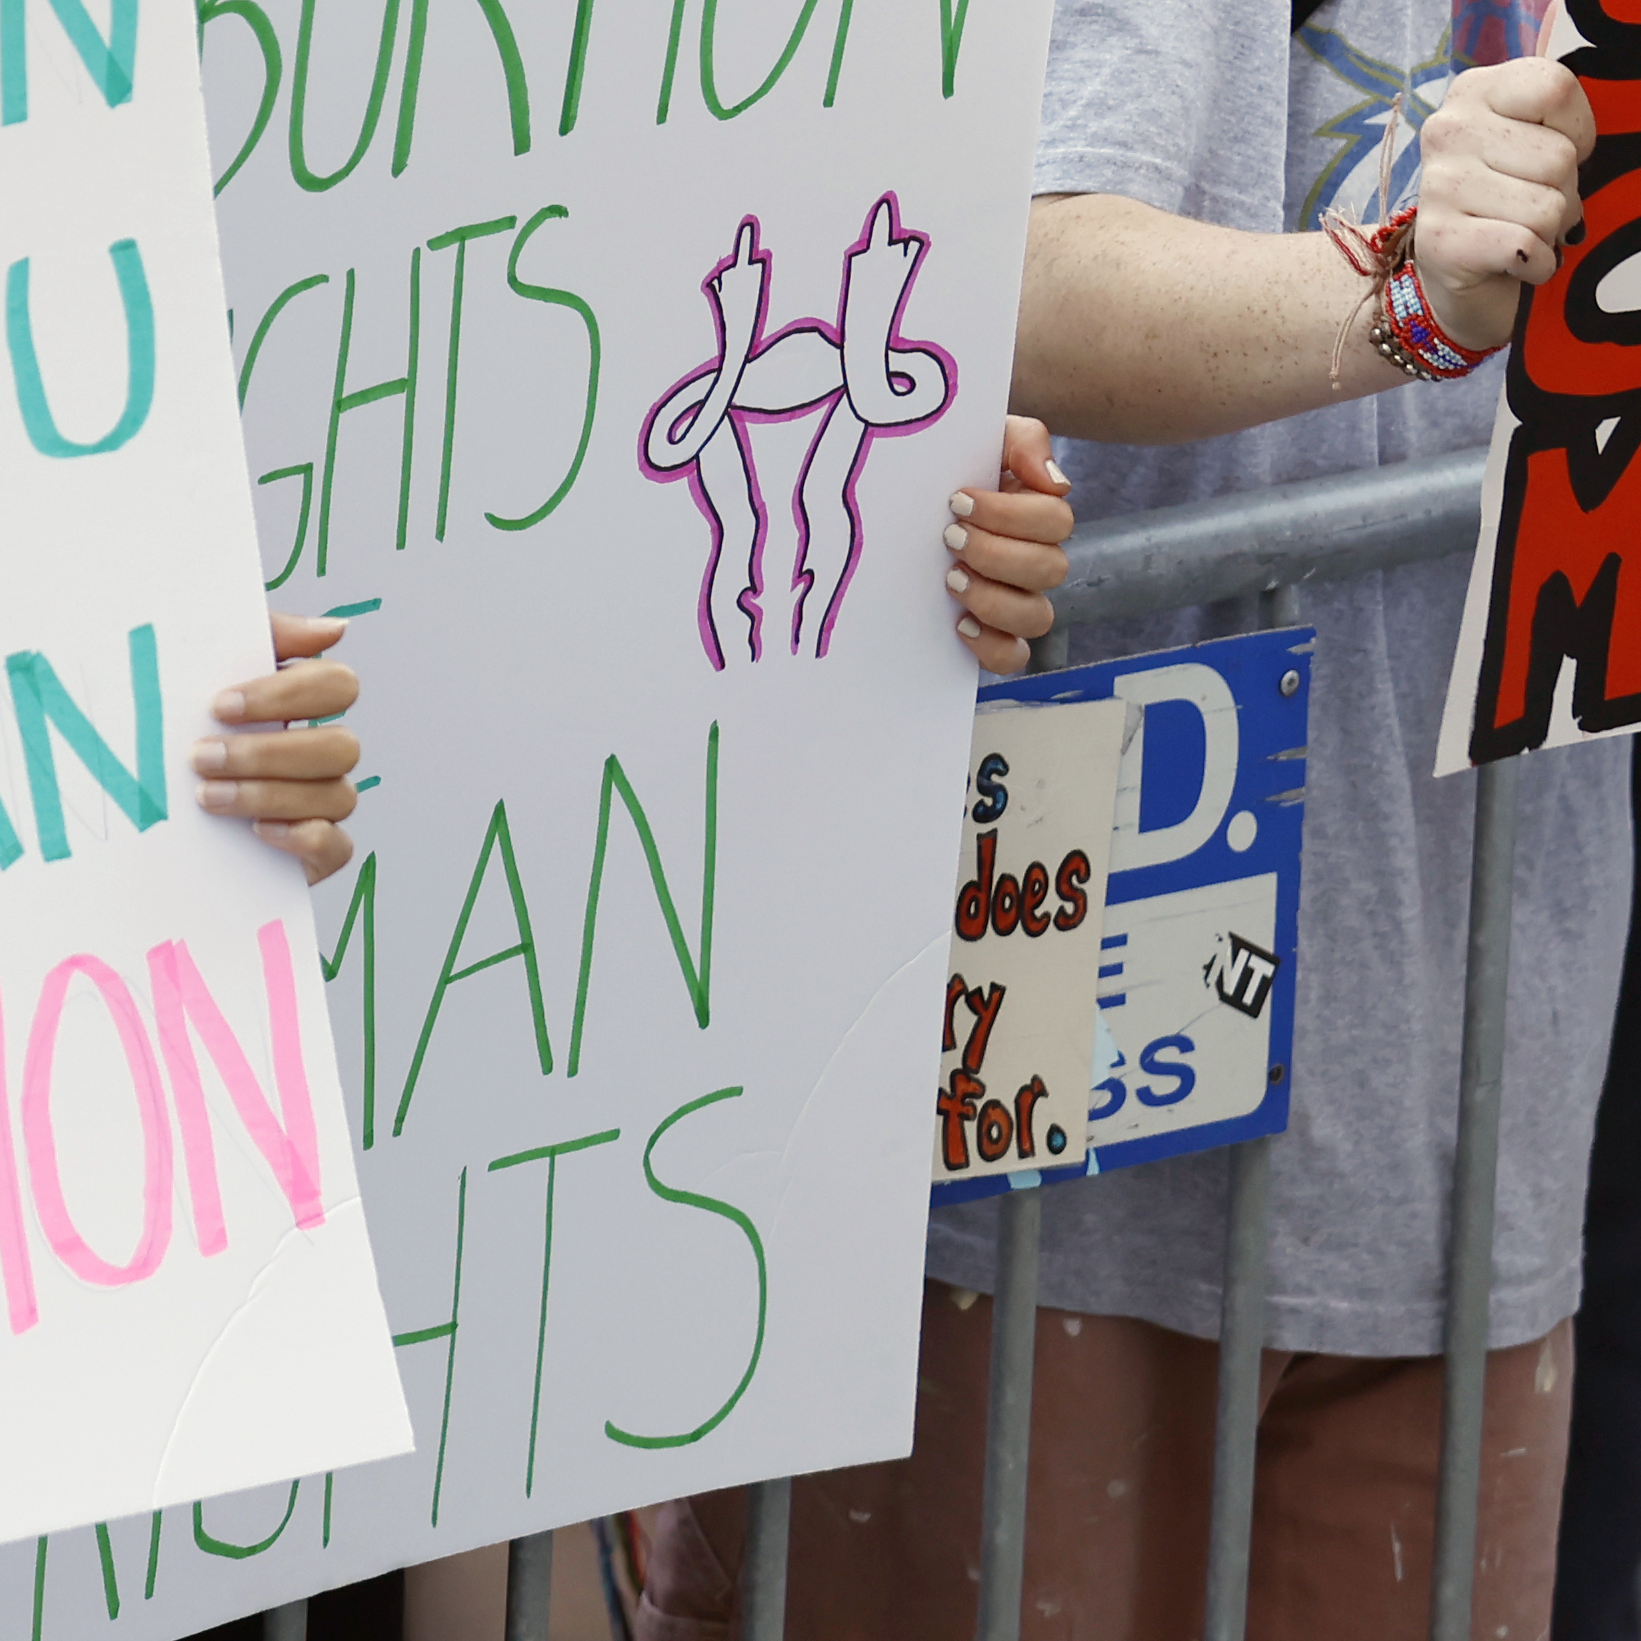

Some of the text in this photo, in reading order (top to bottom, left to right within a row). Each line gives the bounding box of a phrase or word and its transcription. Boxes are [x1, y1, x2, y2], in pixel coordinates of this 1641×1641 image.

[228, 204, 601, 592] GHTS
[963, 751, 1010, 824] s
[955, 828, 1091, 942] does
[936, 1067, 1067, 1171] for.
